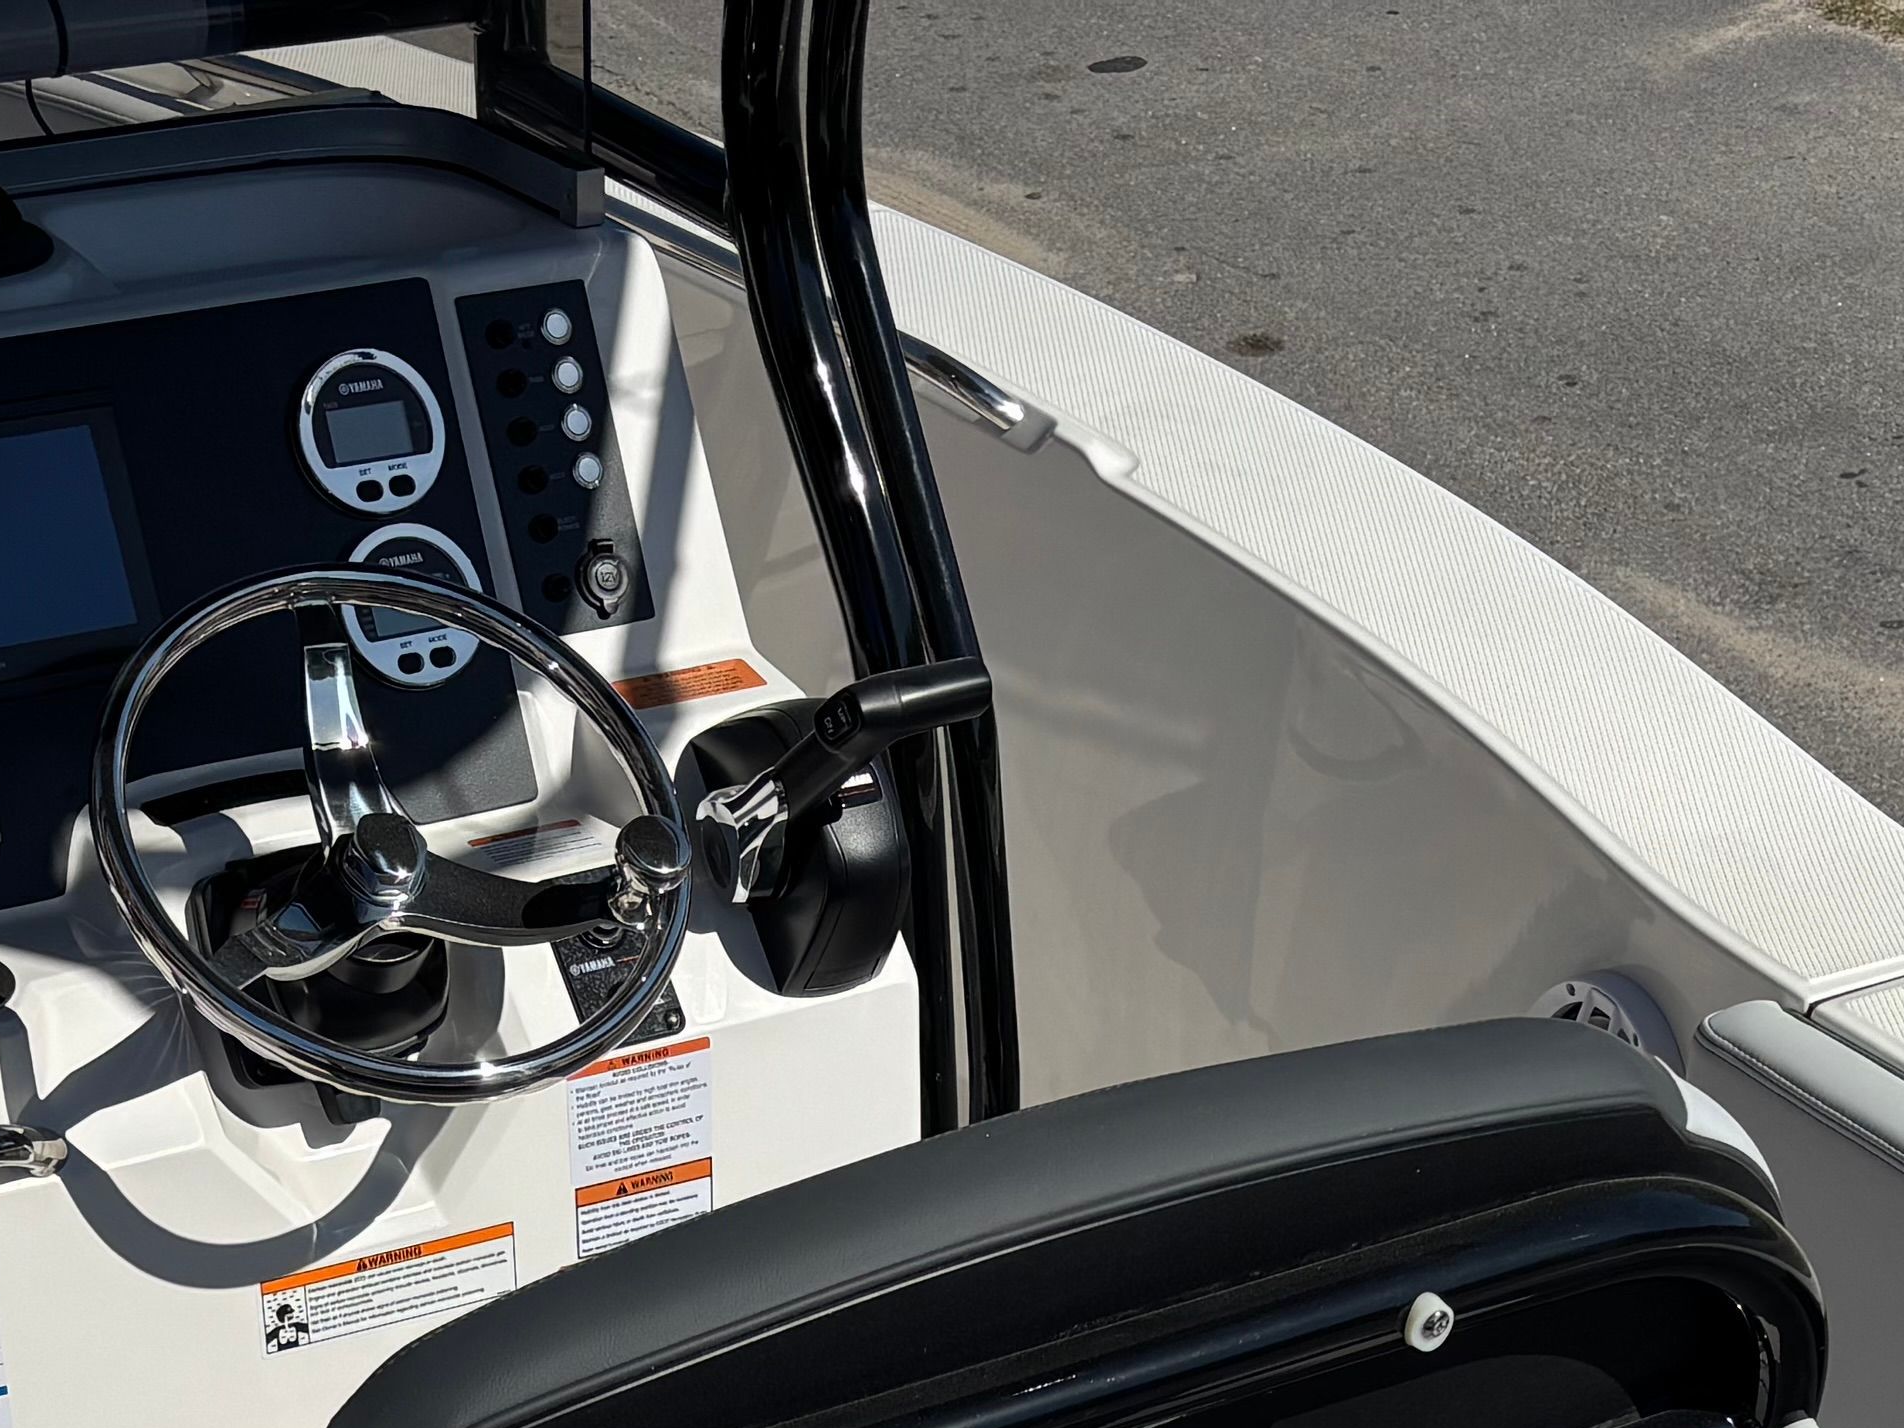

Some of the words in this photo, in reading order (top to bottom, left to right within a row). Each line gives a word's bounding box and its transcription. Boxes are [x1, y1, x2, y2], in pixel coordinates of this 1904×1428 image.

[348, 379, 384, 394] YAMAHA
[389, 551, 425, 568] YAMAHA
[580, 955, 616, 974] YAMAHA
[621, 1048, 669, 1065] WARNING
[630, 1171, 674, 1190] WARNING
[366, 1245, 423, 1269] WARNING
